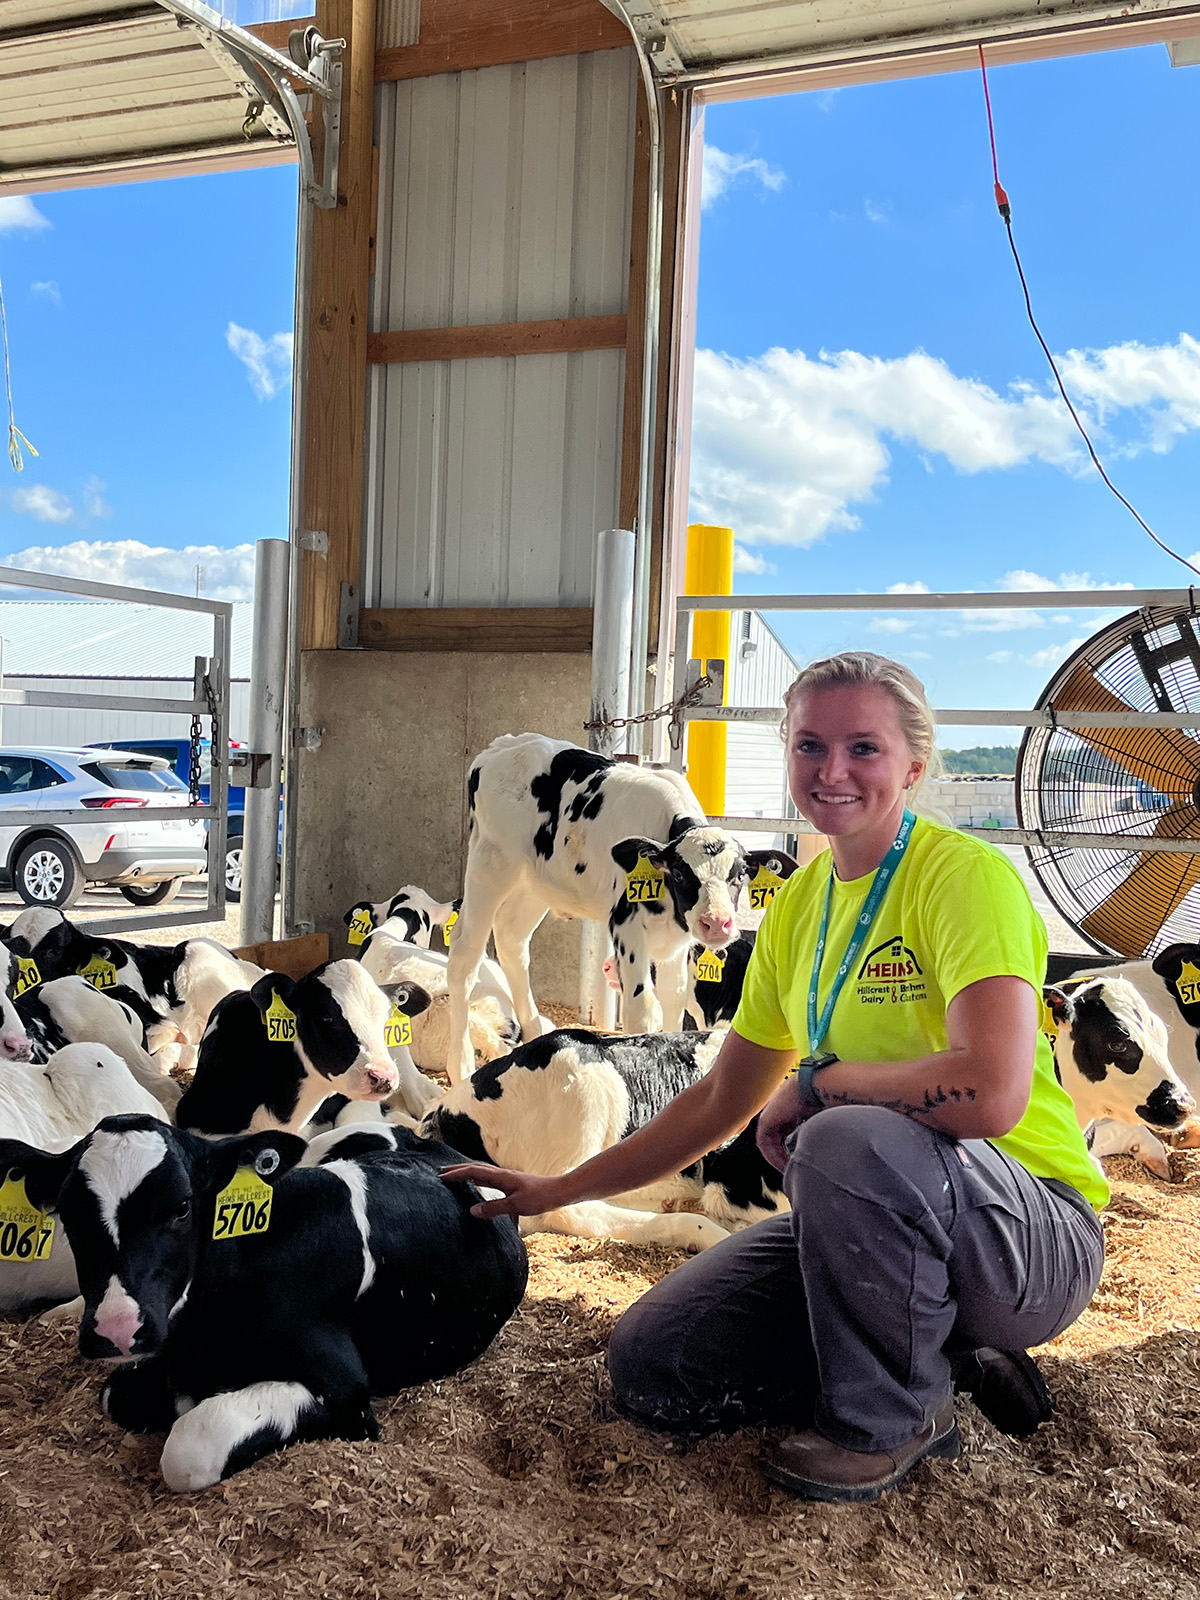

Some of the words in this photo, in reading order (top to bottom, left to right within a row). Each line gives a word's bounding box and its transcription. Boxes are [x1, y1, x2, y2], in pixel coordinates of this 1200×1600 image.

[629, 879, 663, 899] 5717
[751, 886, 781, 908] 571
[698, 964, 719, 980] 5704
[857, 986, 890, 994] Hillcrest
[891, 986, 897, 1003] &
[861, 995, 885, 1004] Dairy
[270, 1018, 296, 1040] 5705
[237, 1189, 271, 1201] HILLCREST
[215, 1199, 270, 1237] 5706
[0, 1222, 37, 1259] 06
